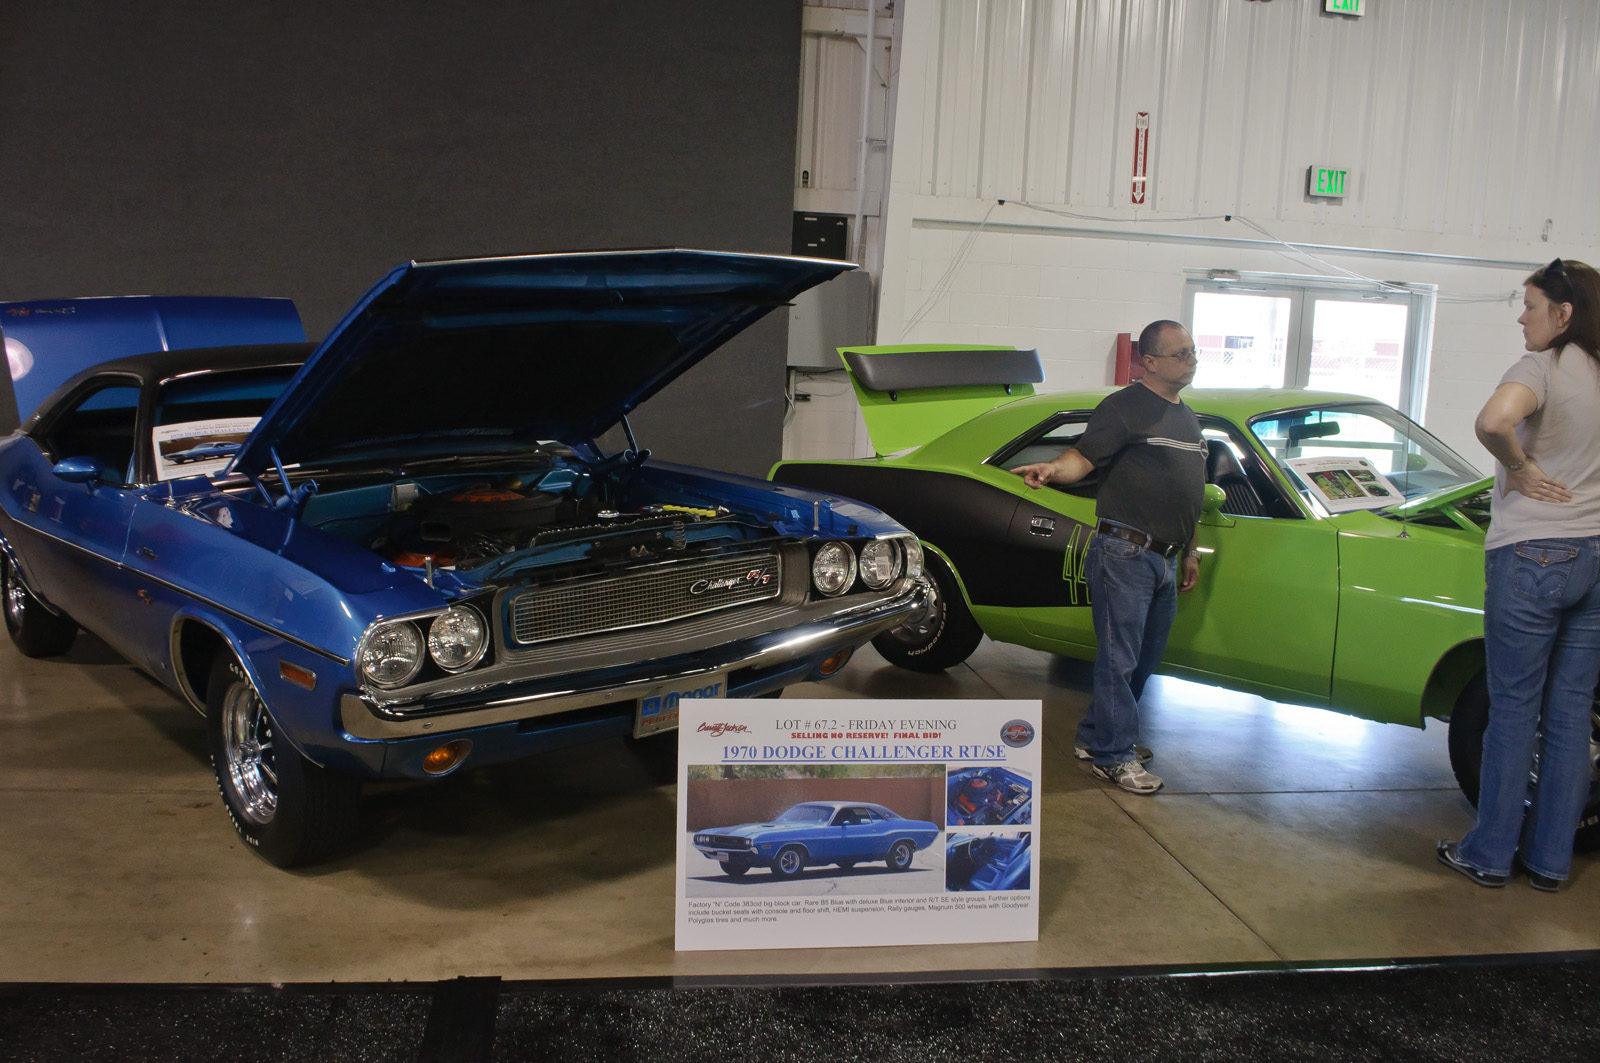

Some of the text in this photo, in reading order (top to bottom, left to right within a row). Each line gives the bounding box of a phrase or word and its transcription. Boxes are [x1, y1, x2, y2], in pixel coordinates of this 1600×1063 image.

[1317, 169, 1346, 194] EXIT
[690, 577, 740, 594] Challenger
[776, 720, 801, 730] LOT
[804, 720, 811, 730] #
[814, 720, 837, 730] 67.2
[849, 720, 896, 730] FRIDAY
[900, 720, 957, 730] EVENING
[723, 744, 1006, 759] 1970 DODGE CHALLENGER RT/SE
[1002, 902, 1029, 910] Goodyear
